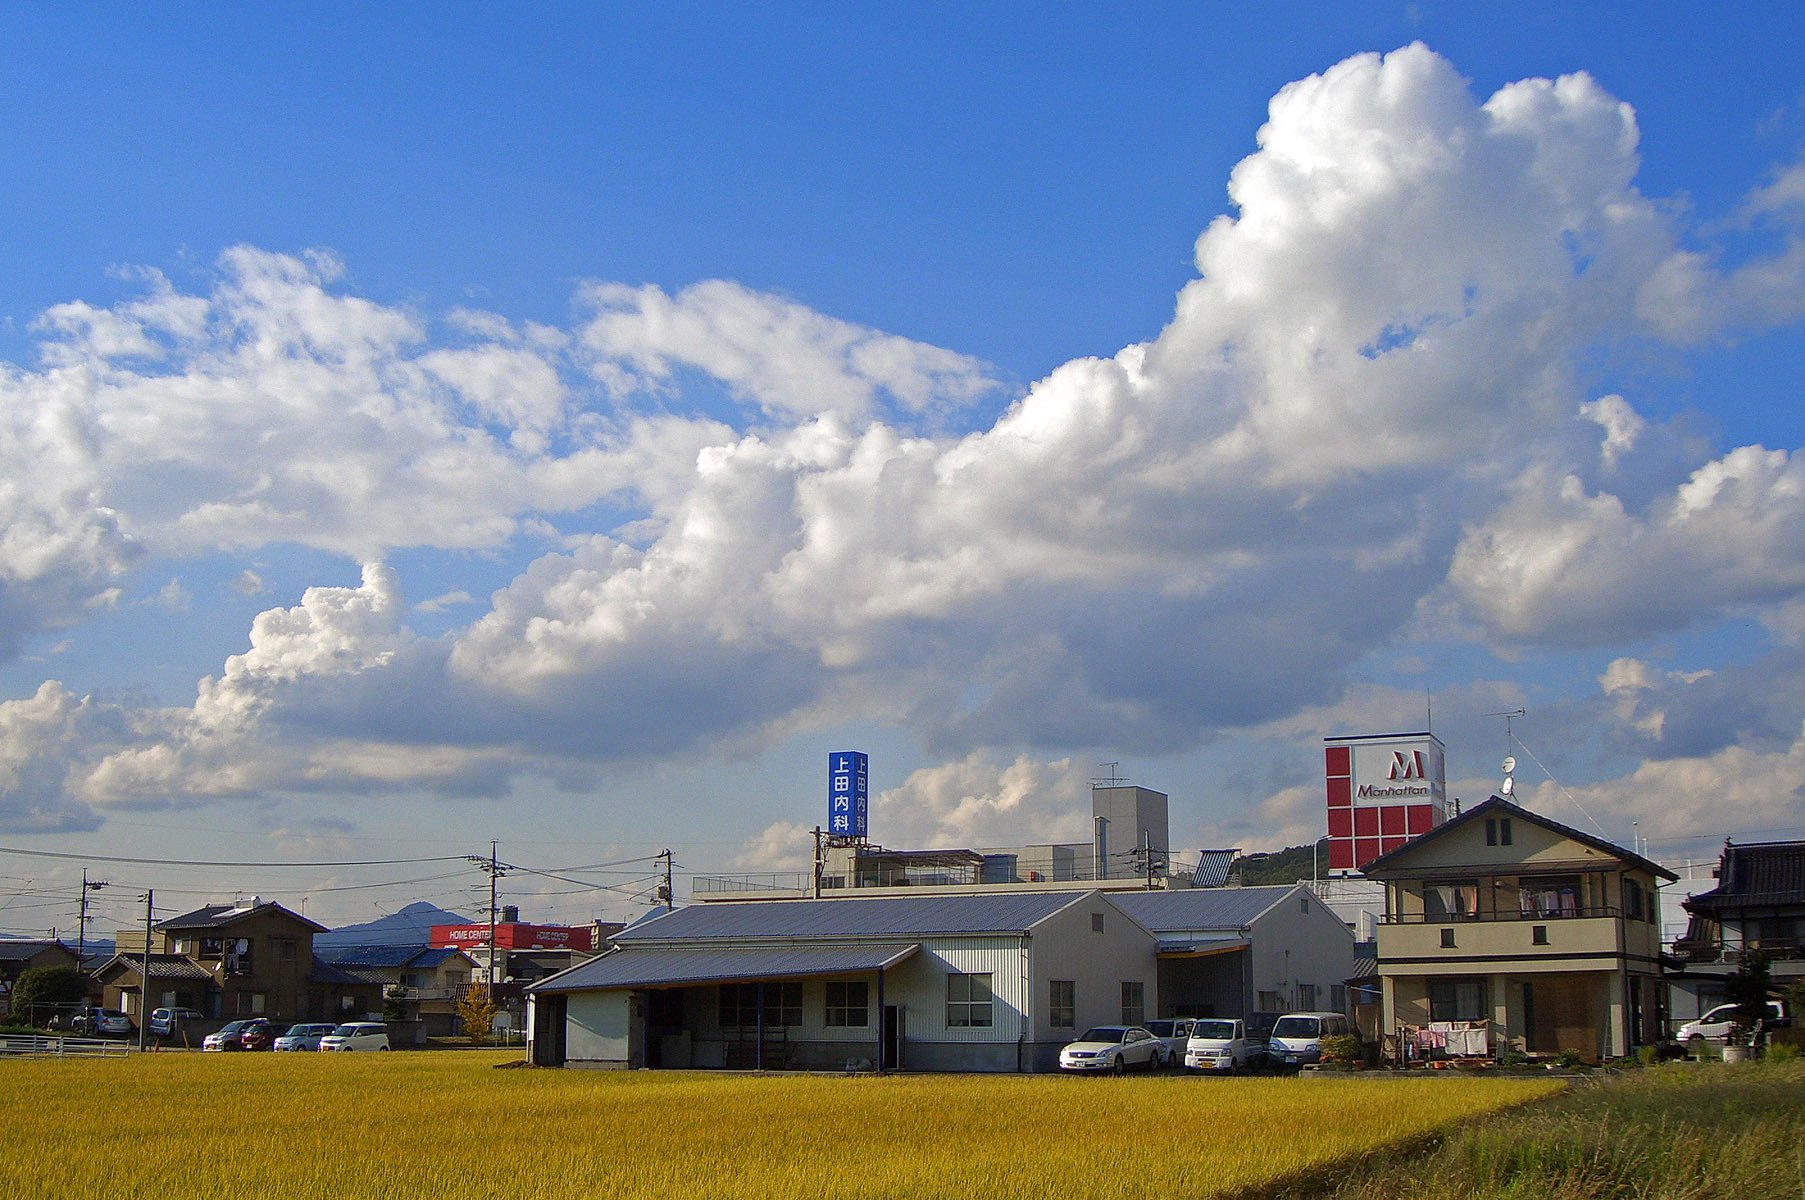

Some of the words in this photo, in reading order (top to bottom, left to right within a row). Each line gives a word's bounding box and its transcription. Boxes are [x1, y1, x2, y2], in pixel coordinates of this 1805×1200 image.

[834, 757, 850, 831] 上田内科
[856, 758, 866, 832] 上田内科
[1356, 784, 1428, 798] Manhattan
[449, 930, 468, 940] HOME
[536, 931, 551, 940] HOME
[551, 931, 569, 941] CENTER
